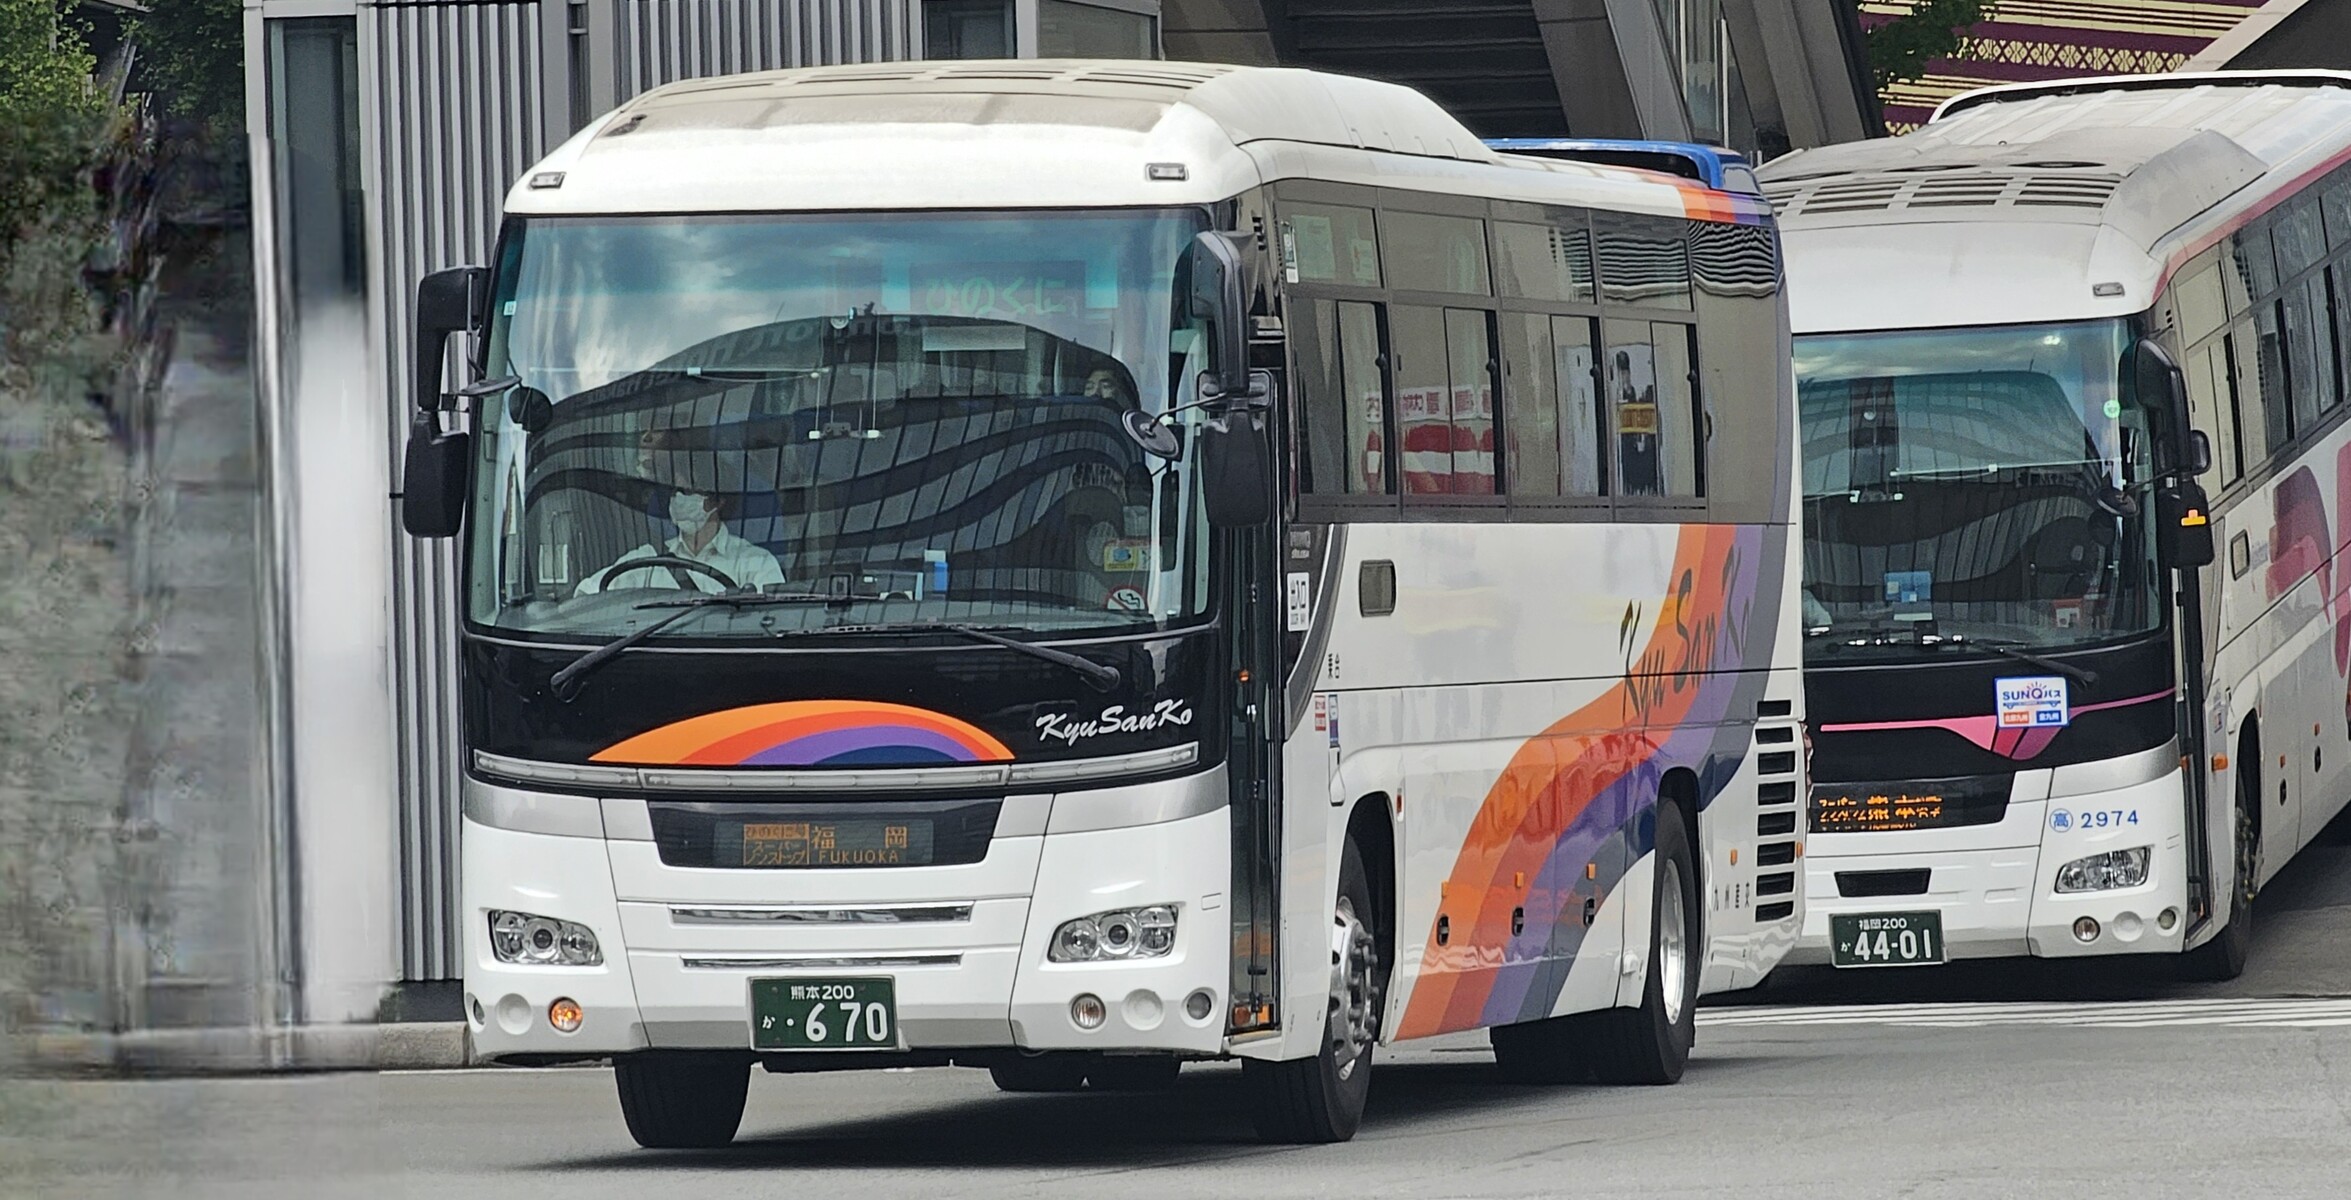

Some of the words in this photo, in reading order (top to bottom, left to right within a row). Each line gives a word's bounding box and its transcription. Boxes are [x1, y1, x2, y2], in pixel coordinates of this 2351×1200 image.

[1036, 699, 1192, 746] KyuSanKo
[2081, 810, 2138, 828] 2974
[818, 850, 899, 864] FUKUOKA
[1841, 942, 1851, 952] か
[1854, 929, 1932, 961] 44-01
[762, 1015, 776, 1029] か
